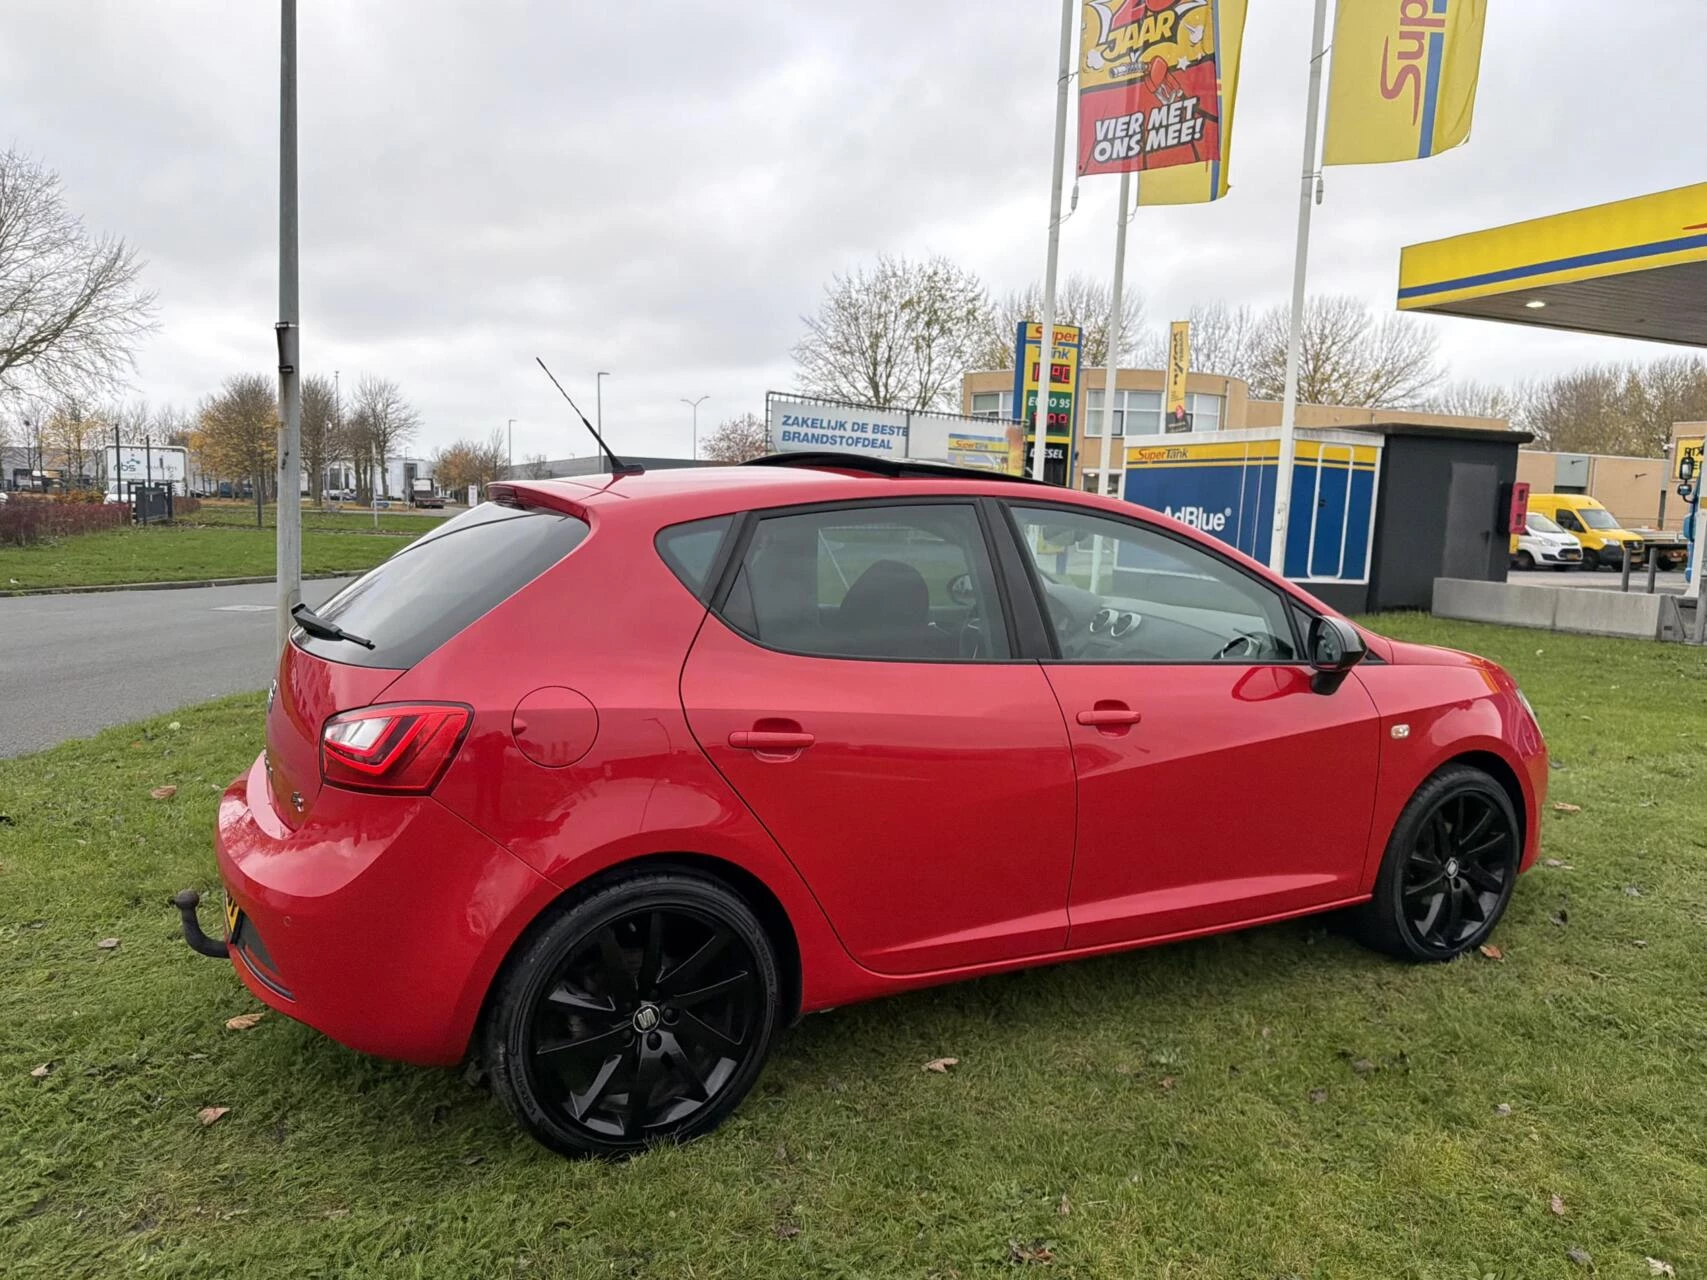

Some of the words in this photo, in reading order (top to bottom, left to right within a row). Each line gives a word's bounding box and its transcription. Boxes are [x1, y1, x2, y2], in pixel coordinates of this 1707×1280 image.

[1102, 10, 1176, 59] JAAR
[1095, 111, 1145, 141] VIER
[1147, 97, 1198, 130] MET
[1094, 133, 1142, 162] ONS
[1145, 118, 1204, 152] MEE!
[1027, 325, 1077, 347] Sper
[1034, 344, 1070, 360] Tnk
[1059, 399, 1071, 409] 95
[782, 415, 848, 432] ZAKELIJK
[851, 422, 869, 433] DE
[872, 424, 909, 437] BESTE
[781, 430, 893, 450] BRANDSTOFDEAL
[1029, 448, 1064, 459] DESEL
